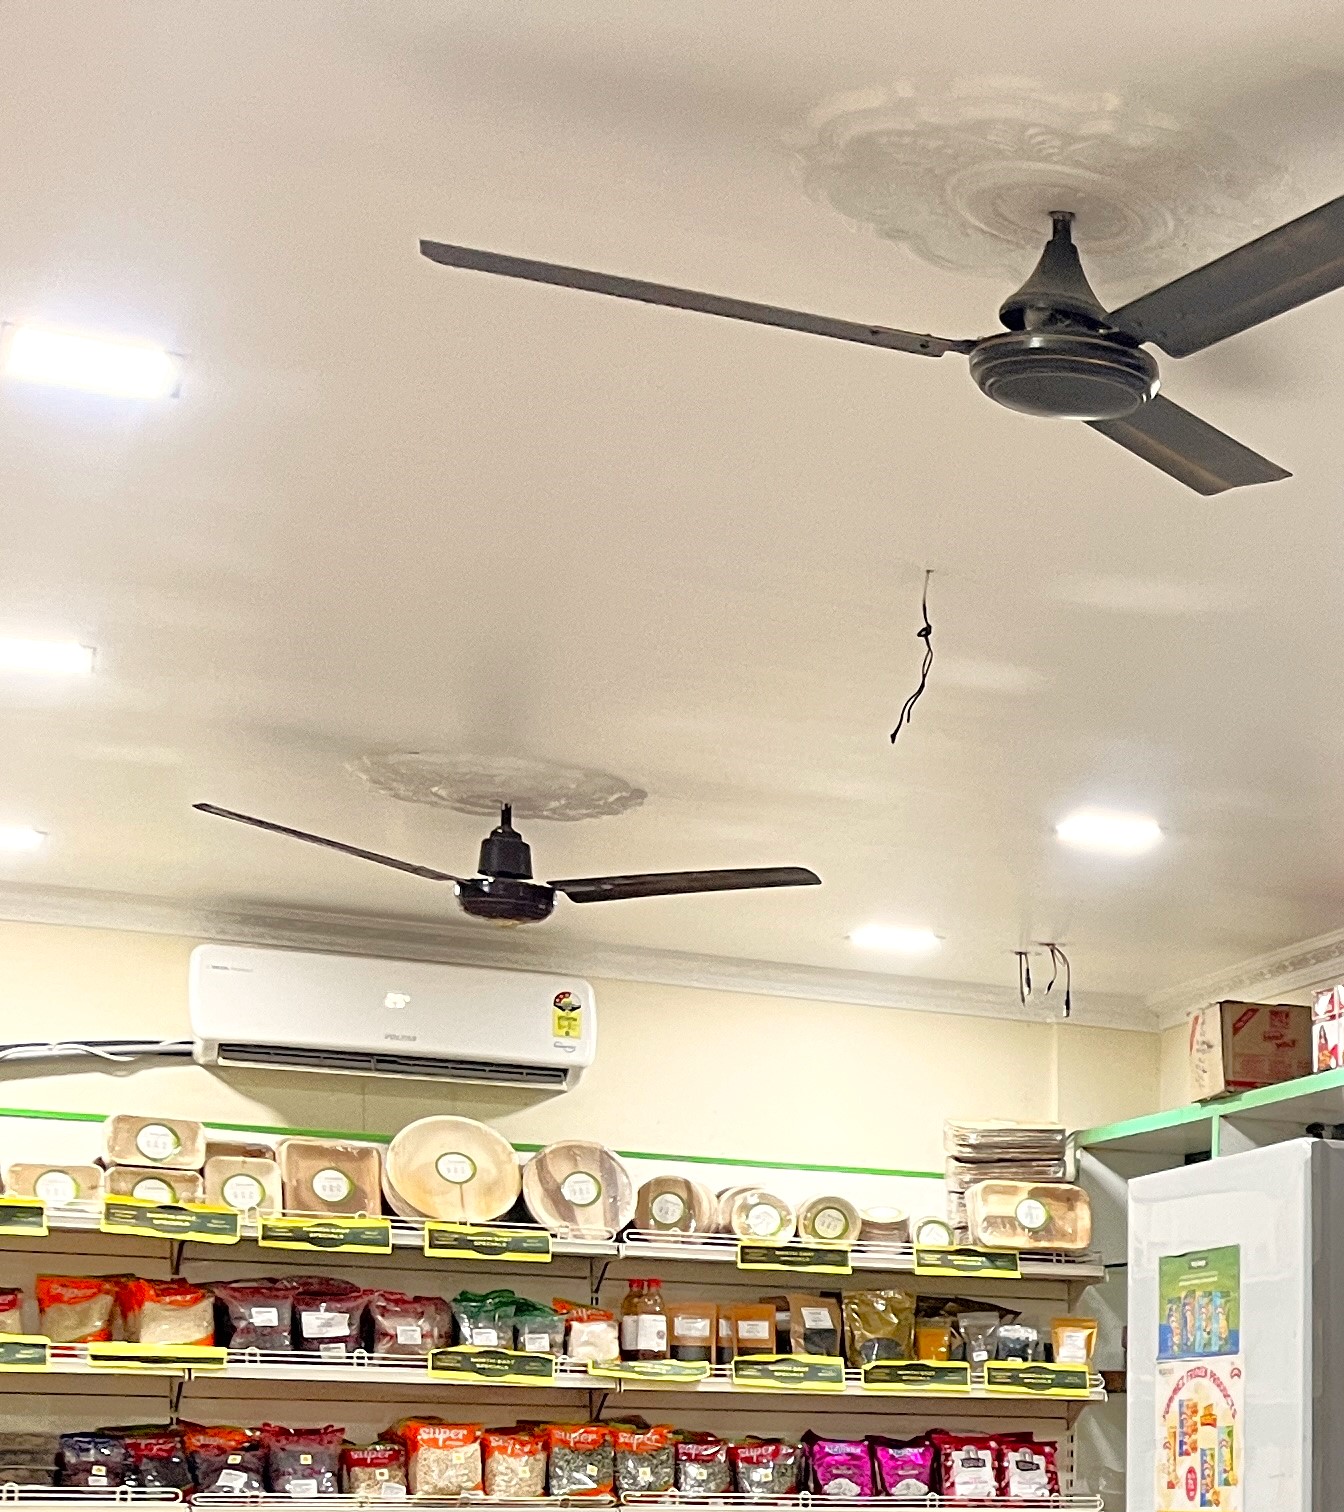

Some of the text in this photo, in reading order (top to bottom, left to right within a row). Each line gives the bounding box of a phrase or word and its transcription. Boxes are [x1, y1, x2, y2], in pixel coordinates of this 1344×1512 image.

[419, 1427, 467, 1447] super
[556, 1429, 599, 1446] super
[618, 1431, 663, 1450] super
